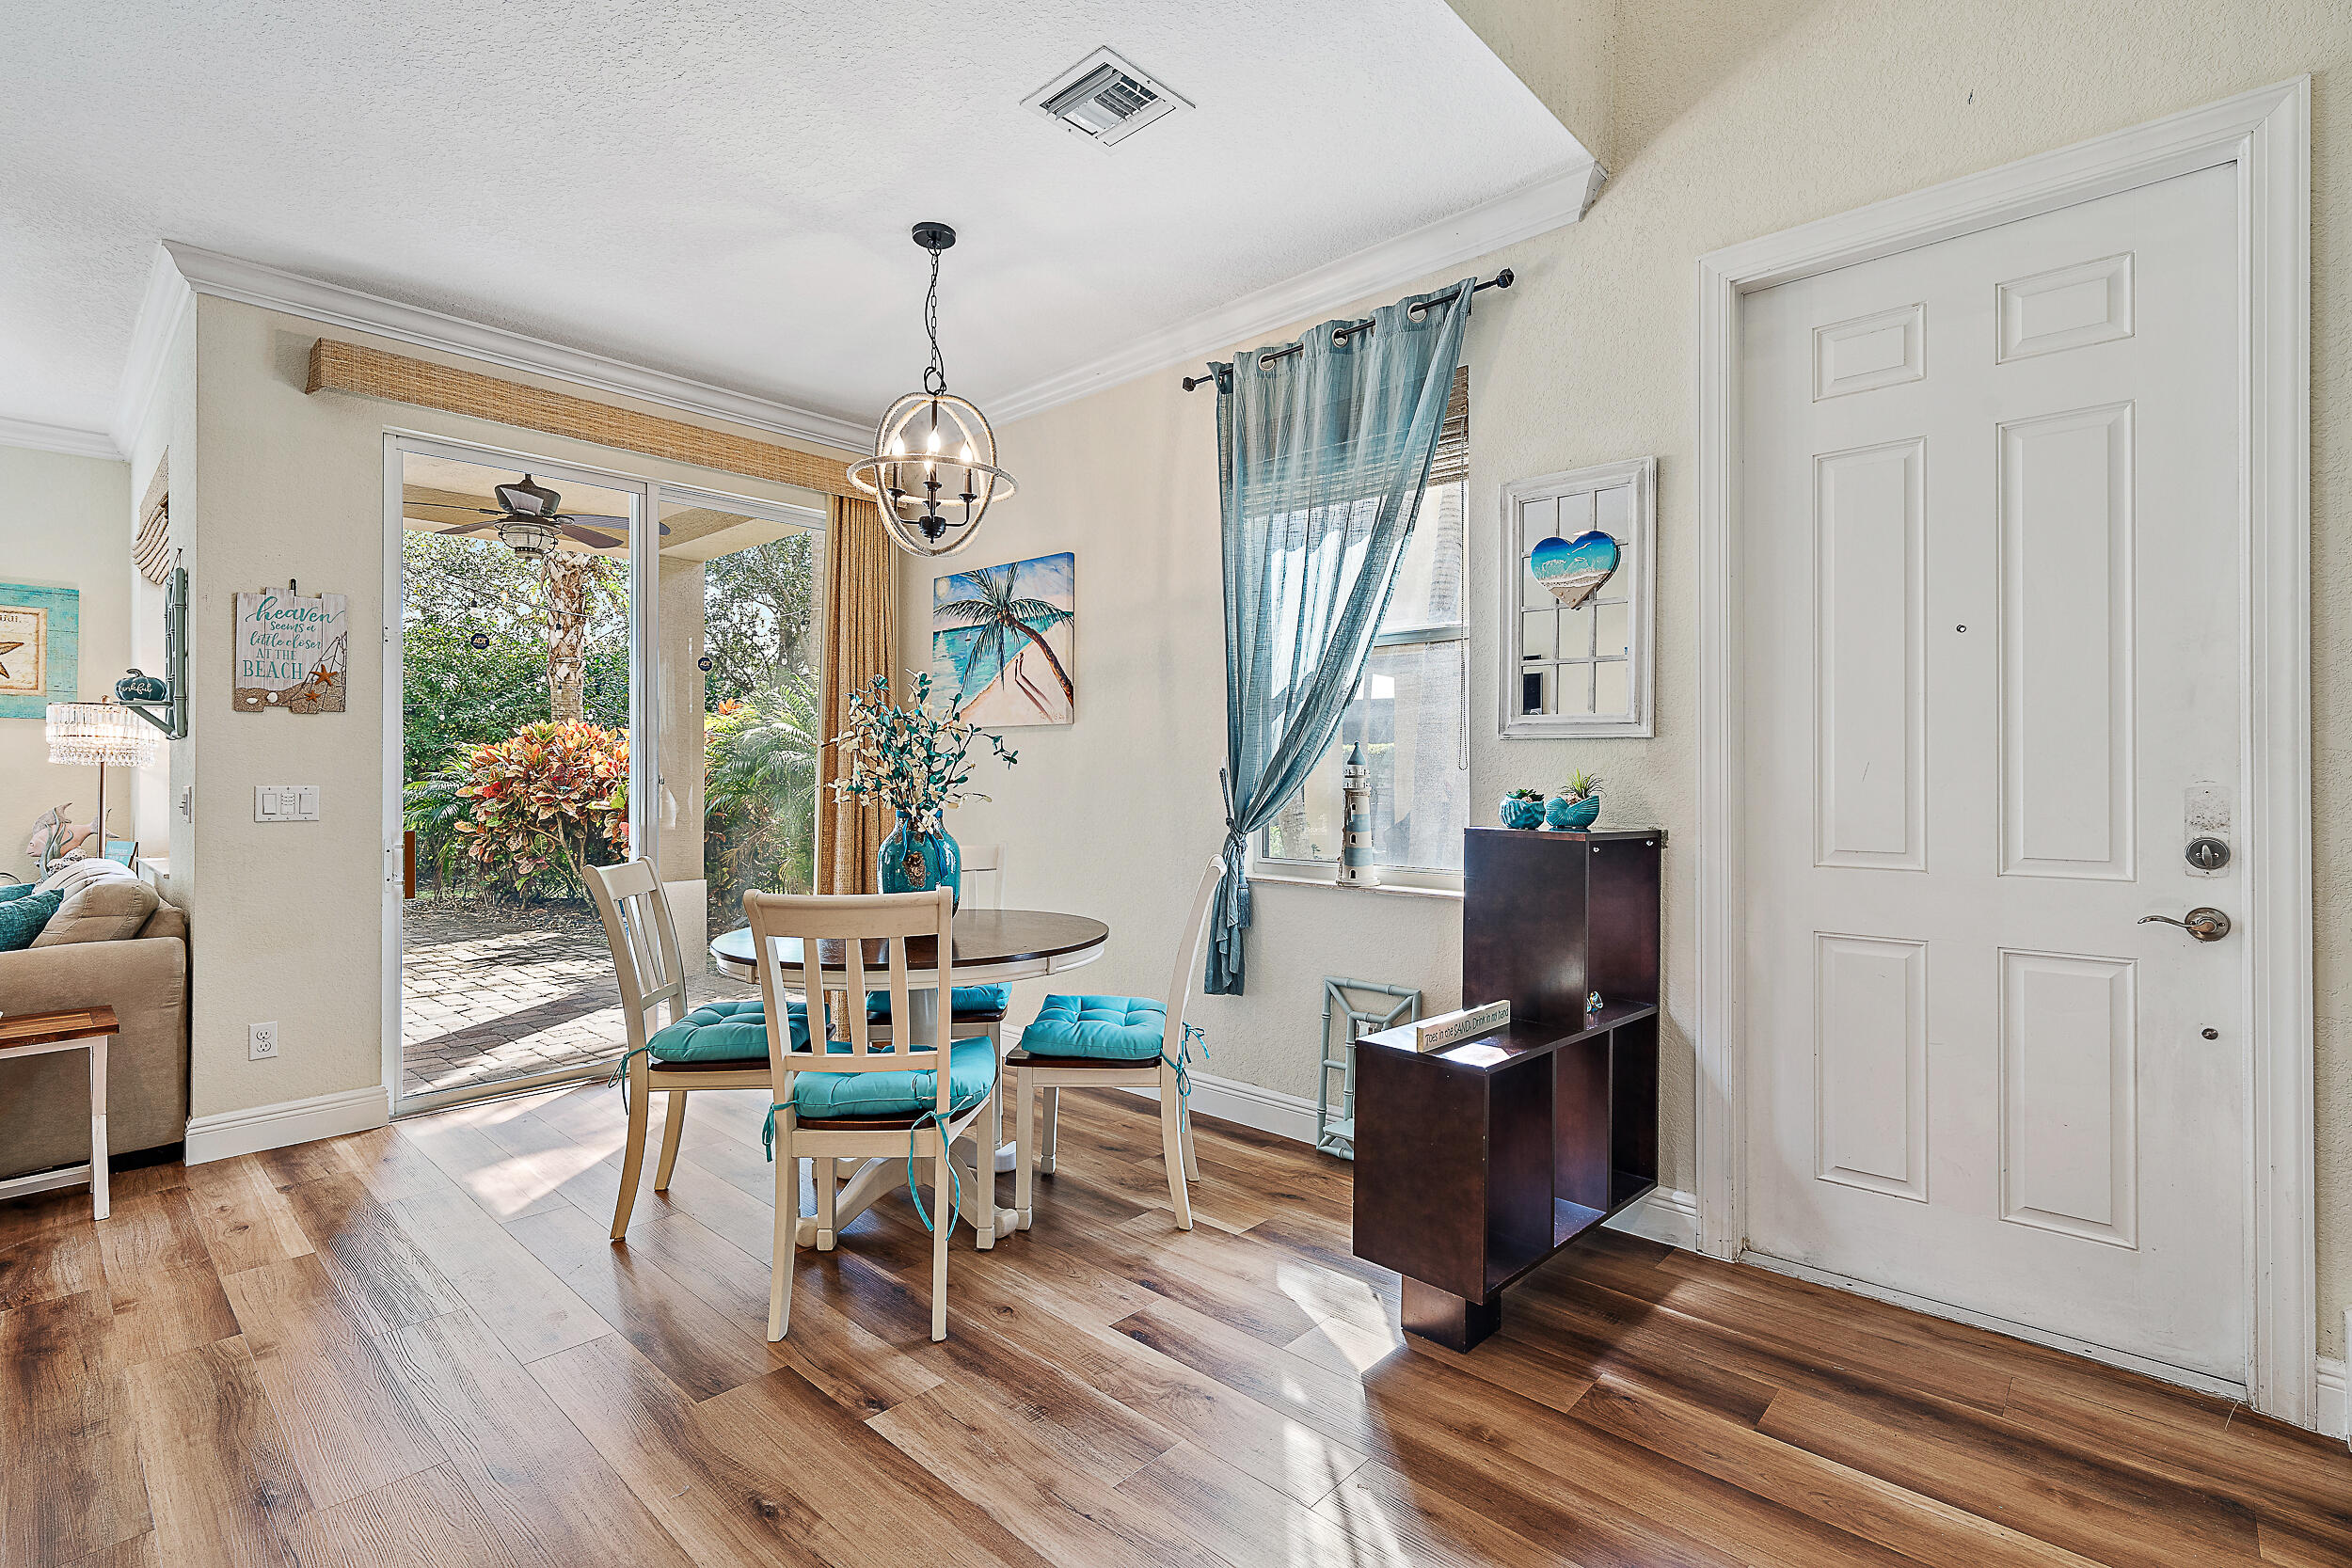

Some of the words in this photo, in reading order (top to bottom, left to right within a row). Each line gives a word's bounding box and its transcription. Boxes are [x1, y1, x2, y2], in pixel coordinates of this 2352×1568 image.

[246, 596, 345, 624] heaven
[270, 621, 304, 633] seems
[250, 631, 284, 648] little
[286, 634, 323, 650] closer
[256, 648, 273, 659] AT
[275, 649, 296, 661] THE
[243, 659, 303, 680] BEACH
[1424, 1032, 1438, 1046] Toes
[1438, 1029, 1444, 1039] in
[1472, 1016, 1486, 1030] Drink
[1486, 1013, 1490, 1022] in
[1498, 1006, 1509, 1020] hand
